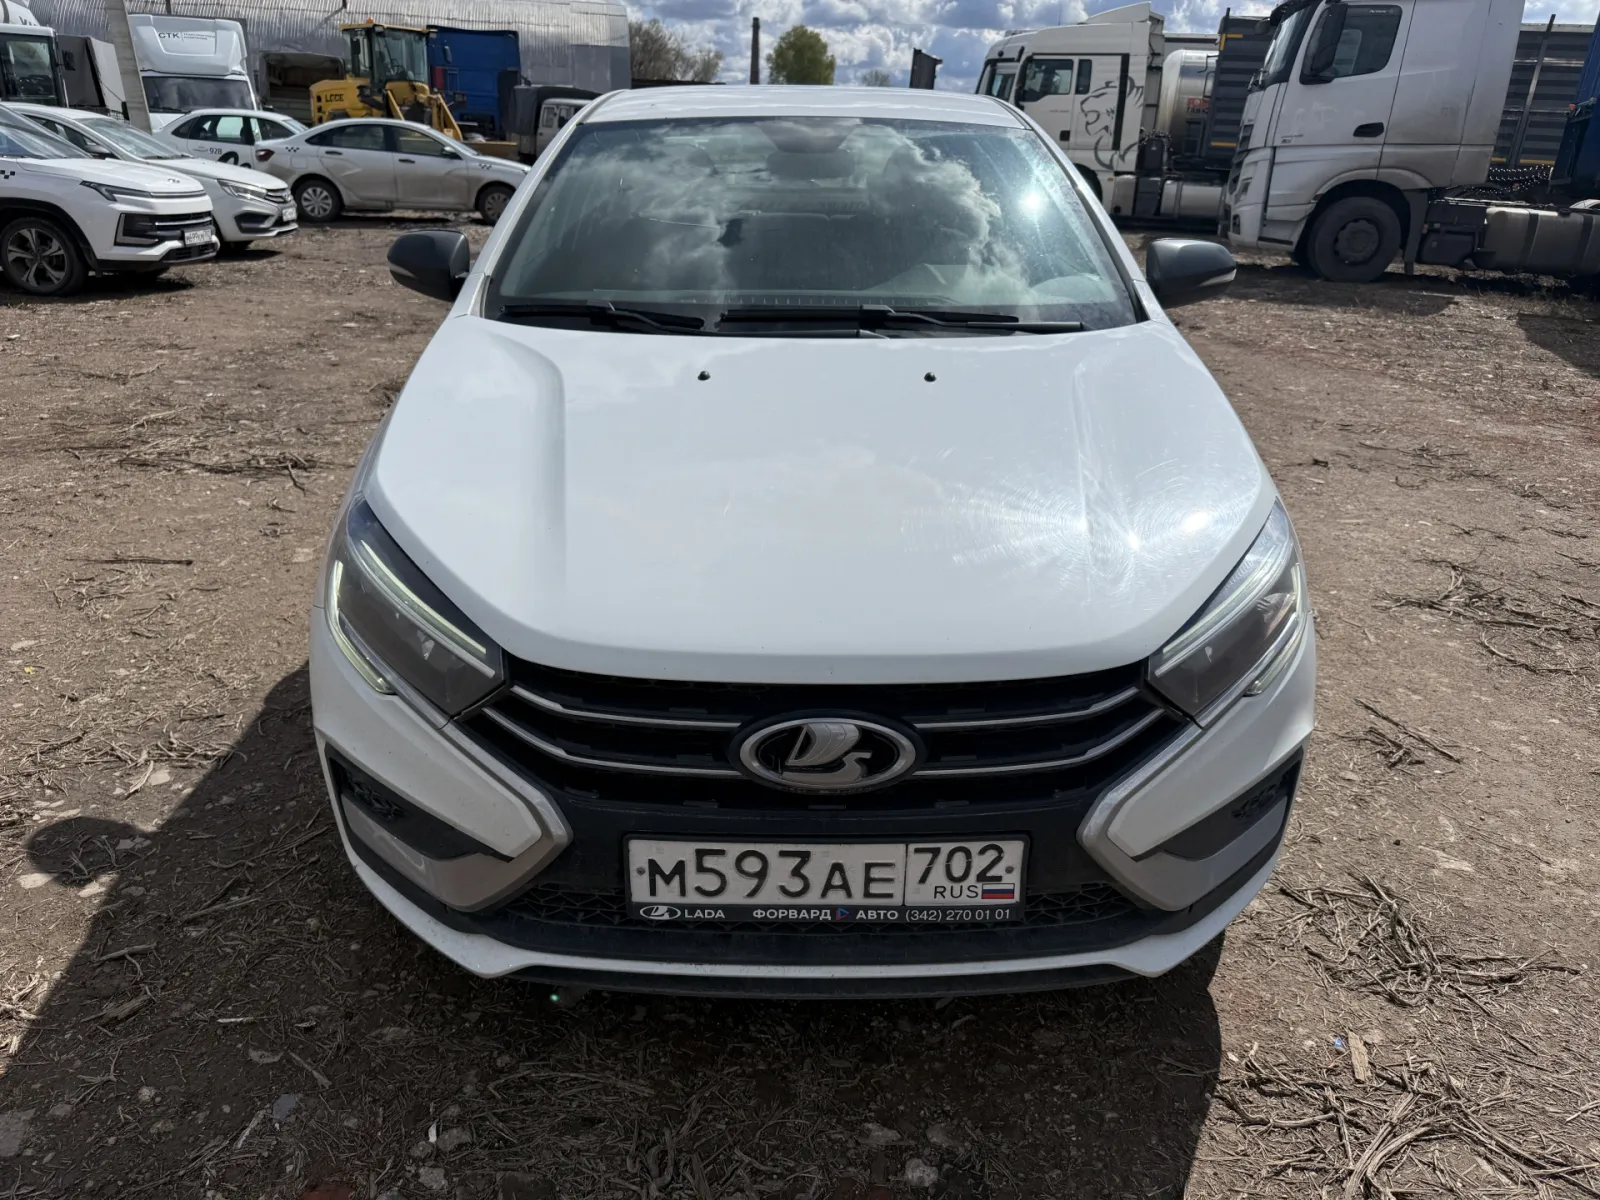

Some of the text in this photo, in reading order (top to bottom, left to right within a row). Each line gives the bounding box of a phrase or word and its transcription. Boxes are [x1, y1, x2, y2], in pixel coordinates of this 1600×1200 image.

[648, 843, 1005, 898] М593АЕ 702
[933, 884, 979, 899] RUS
[684, 909, 726, 919] LADA
[752, 909, 1010, 922] ФОРВАРД АВТО (342) 270 01 01
